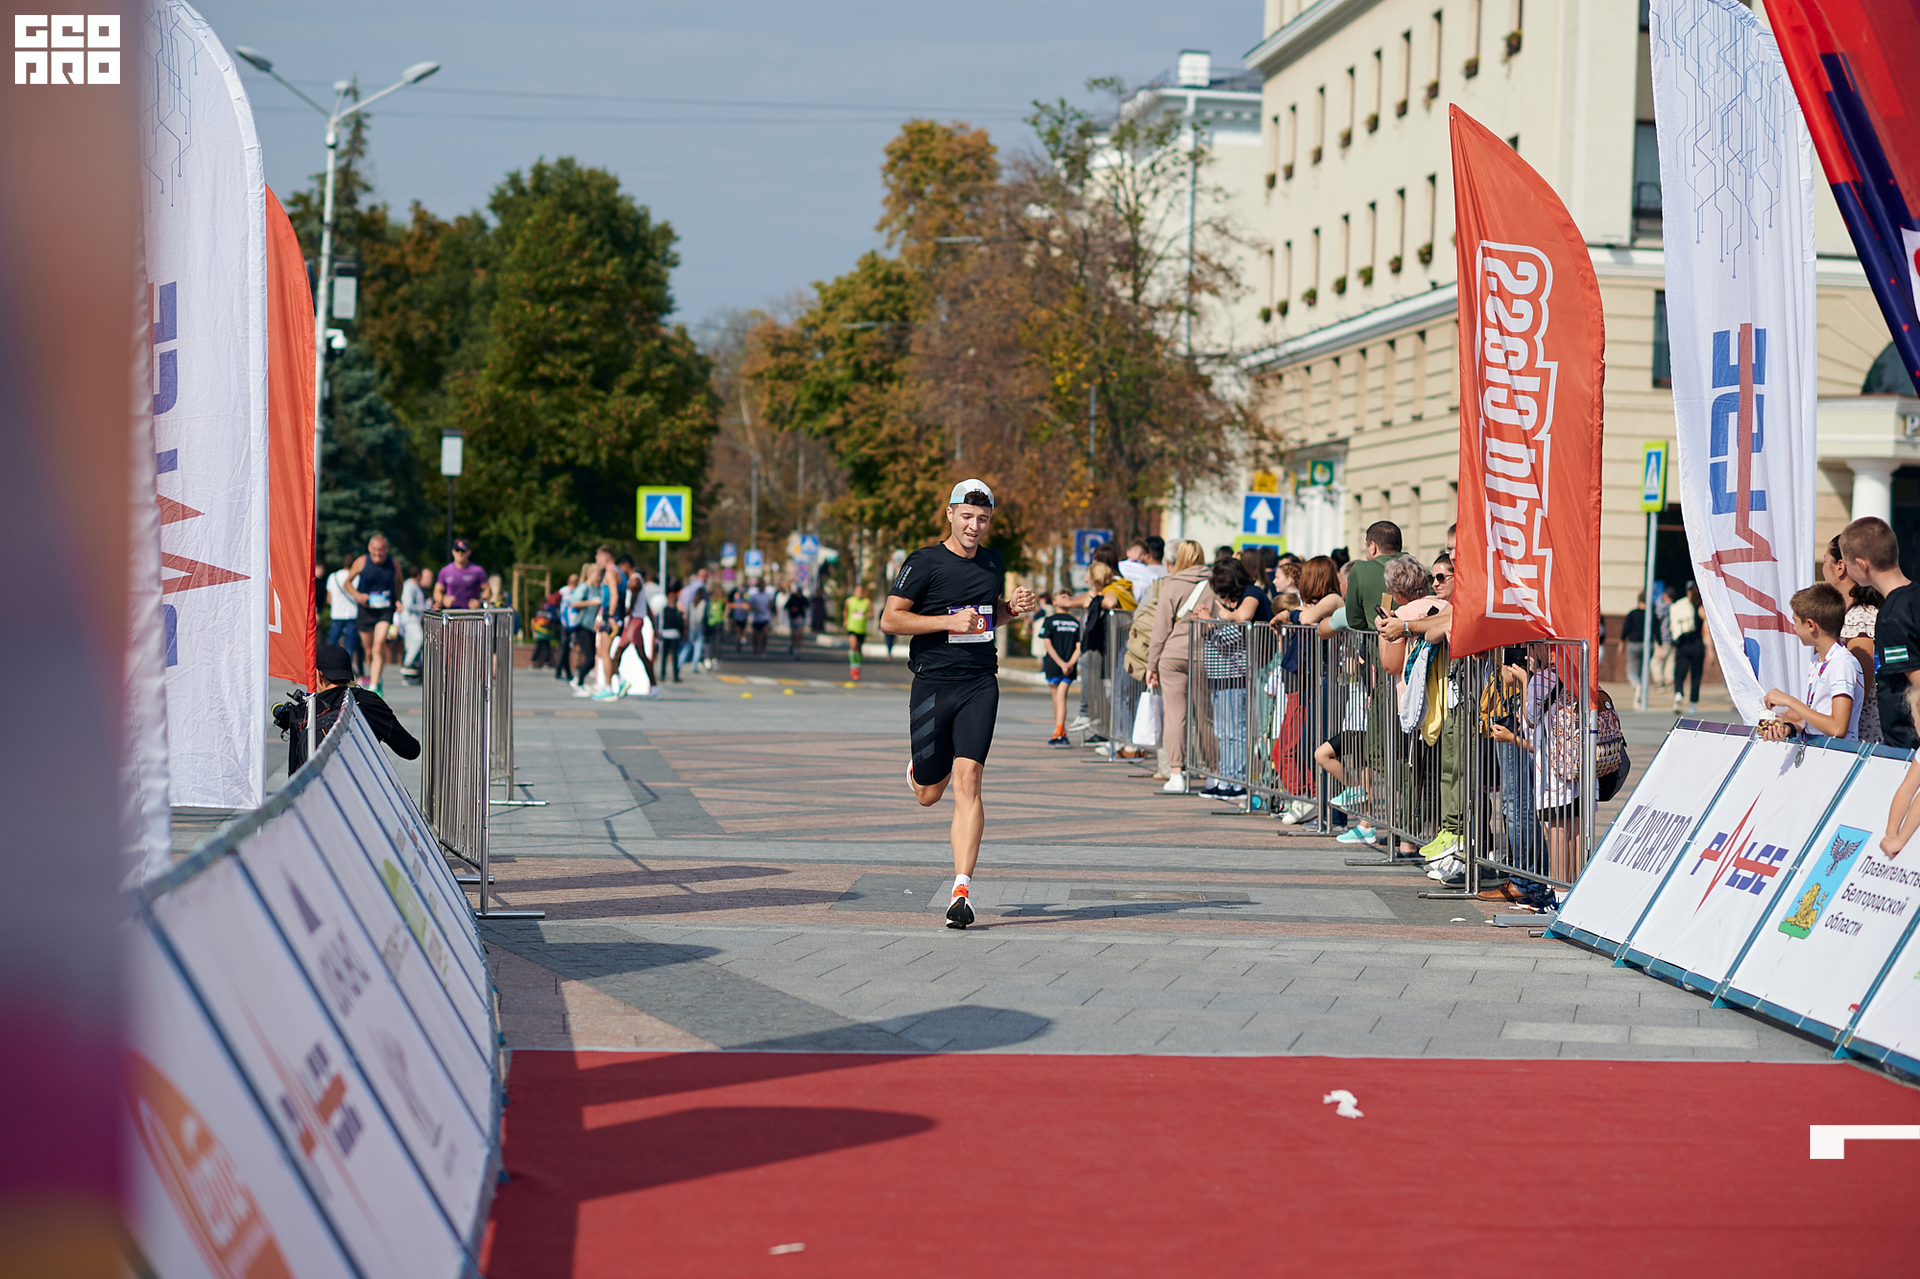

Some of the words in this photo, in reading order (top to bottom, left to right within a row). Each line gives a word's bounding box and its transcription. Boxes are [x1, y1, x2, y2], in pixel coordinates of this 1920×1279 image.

[1621, 809, 1693, 876] РУСАГРО
[1858, 855, 1920, 888] Правительств
[1841, 882, 1910, 917] Белгородской
[1825, 911, 1863, 937] области
